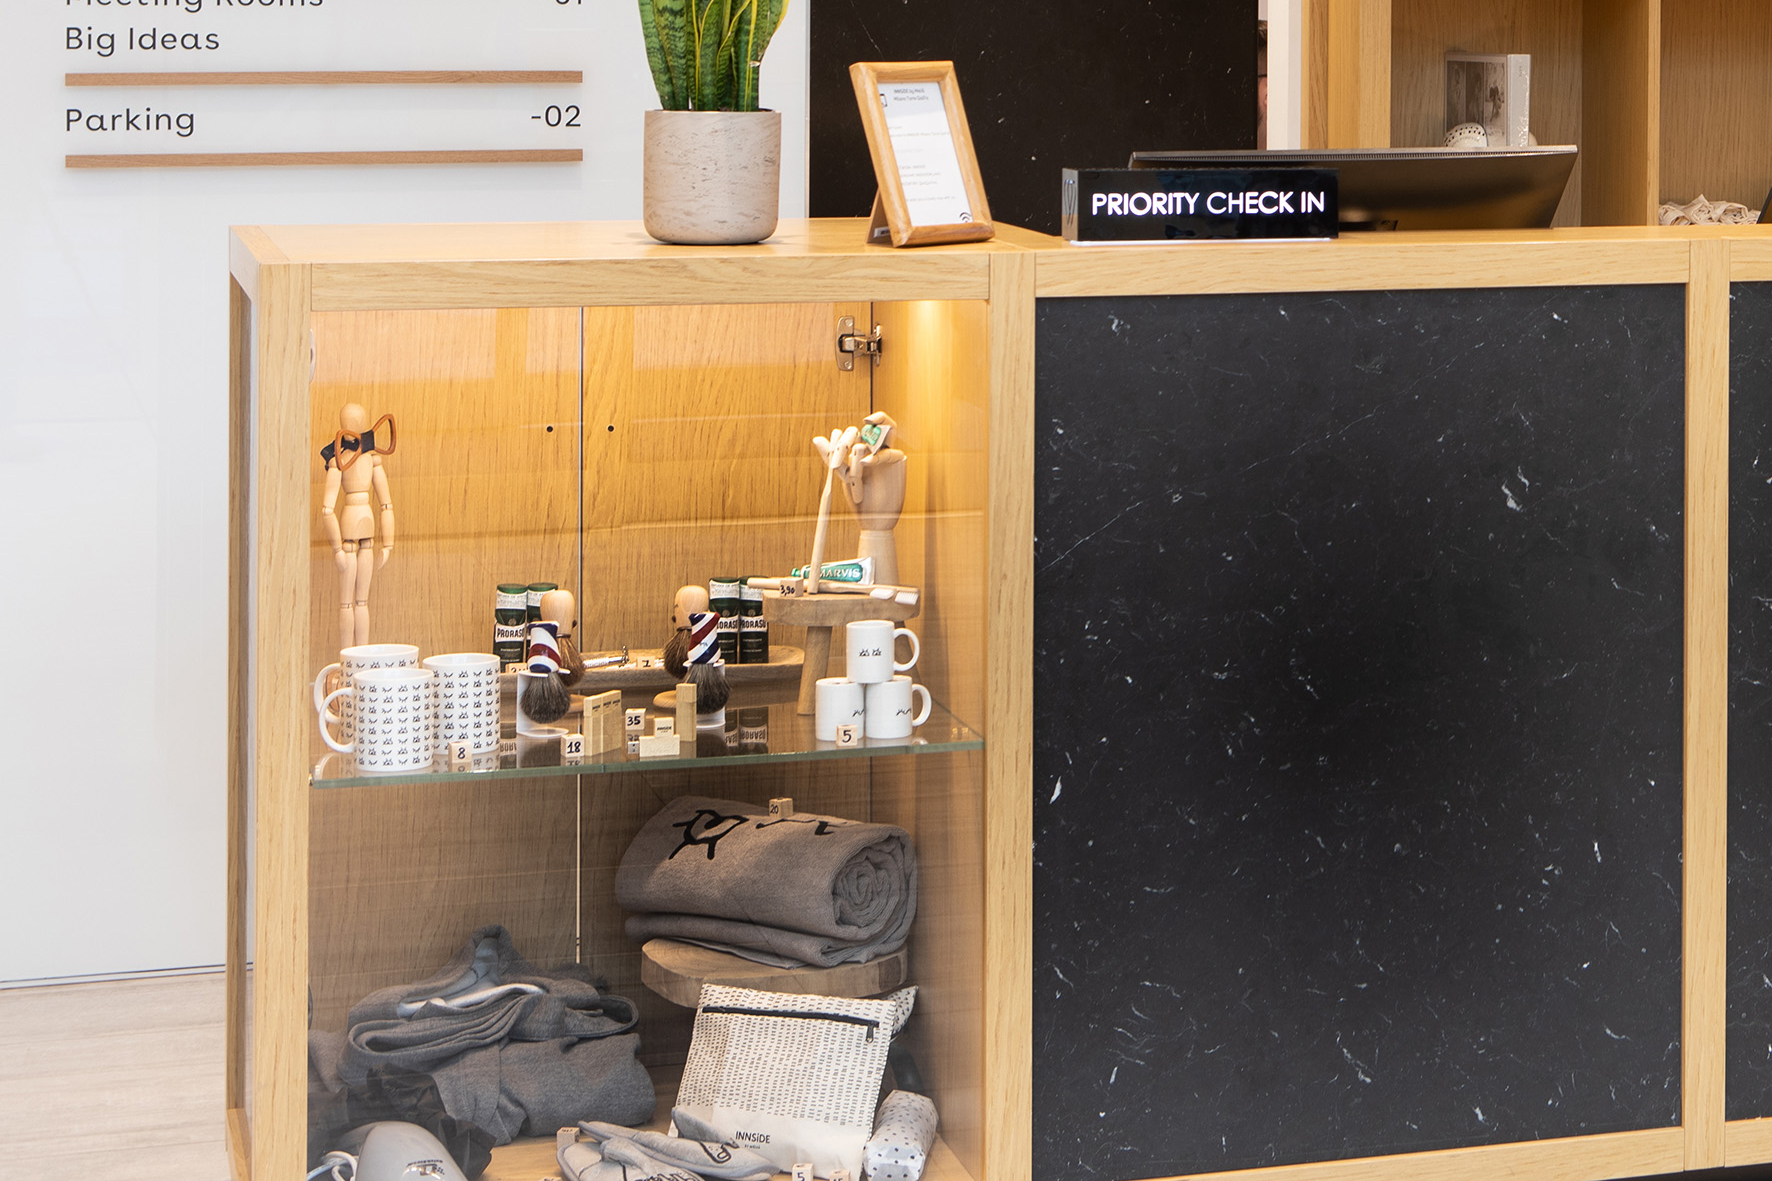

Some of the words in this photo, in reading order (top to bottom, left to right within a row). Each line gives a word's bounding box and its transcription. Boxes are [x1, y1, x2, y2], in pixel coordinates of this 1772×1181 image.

[66, 26, 115, 58] Big
[129, 27, 220, 51] Ideas
[66, 107, 194, 138] Parking
[531, 104, 581, 128] -02
[1092, 192, 1200, 216] PRIORITY
[1206, 190, 1295, 215] CHECK
[1300, 191, 1325, 214] IN
[780, 584, 796, 596] 3,90
[627, 715, 641, 726] 35
[841, 729, 852, 743] 5
[457, 747, 466, 760] 8
[567, 741, 581, 754] 18
[769, 804, 779, 815] 20
[735, 1130, 771, 1144] INNSiDE
[797, 1171, 805, 1181] 5
